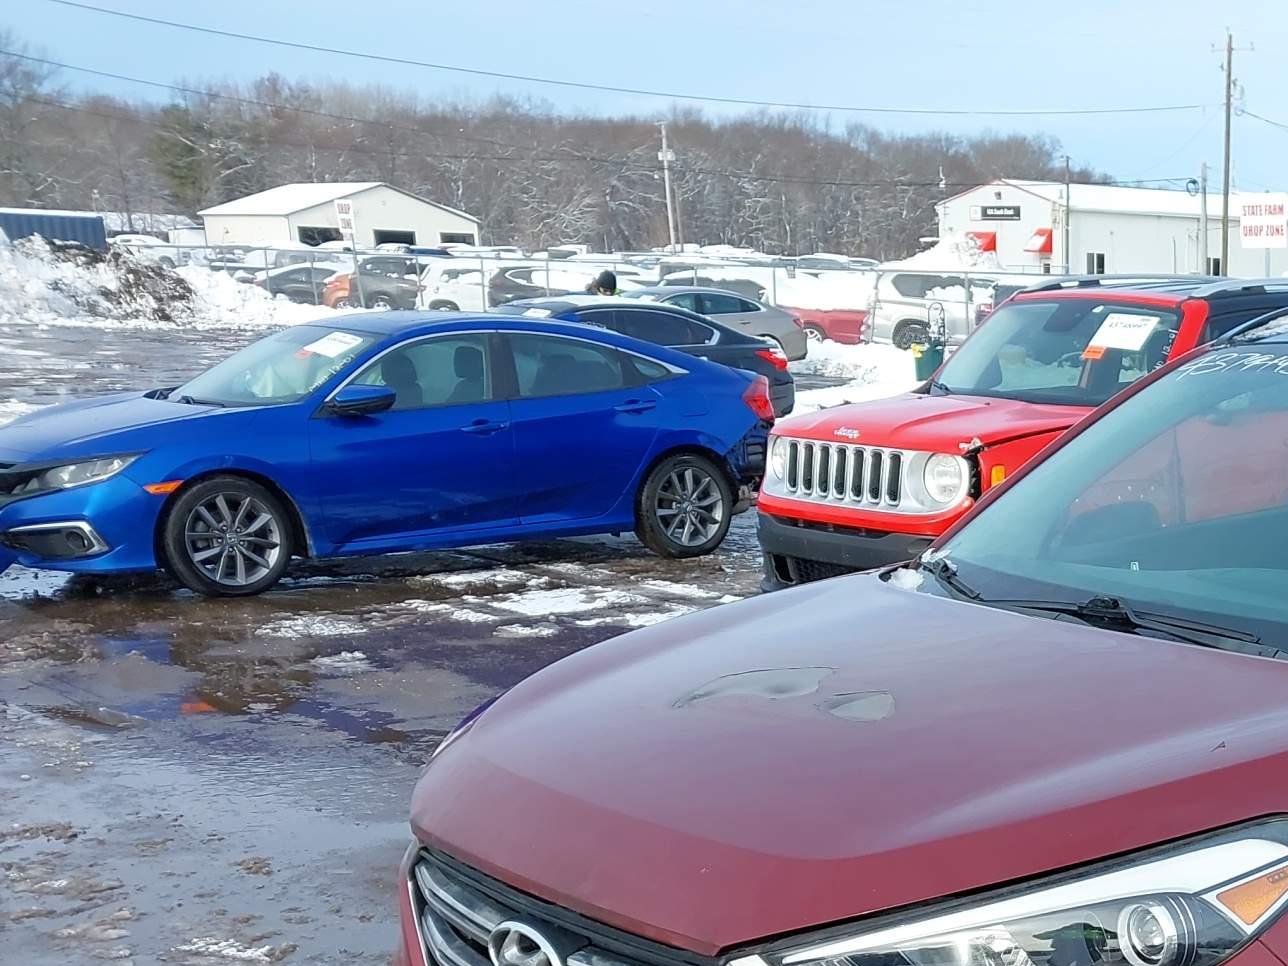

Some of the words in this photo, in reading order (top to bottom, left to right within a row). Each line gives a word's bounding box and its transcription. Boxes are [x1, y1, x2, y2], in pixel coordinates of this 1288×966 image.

[1242, 205, 1263, 216] STATE
[1264, 204, 1284, 216] FARM
[1243, 225, 1263, 236] DROP
[1266, 225, 1284, 236] ZONE
